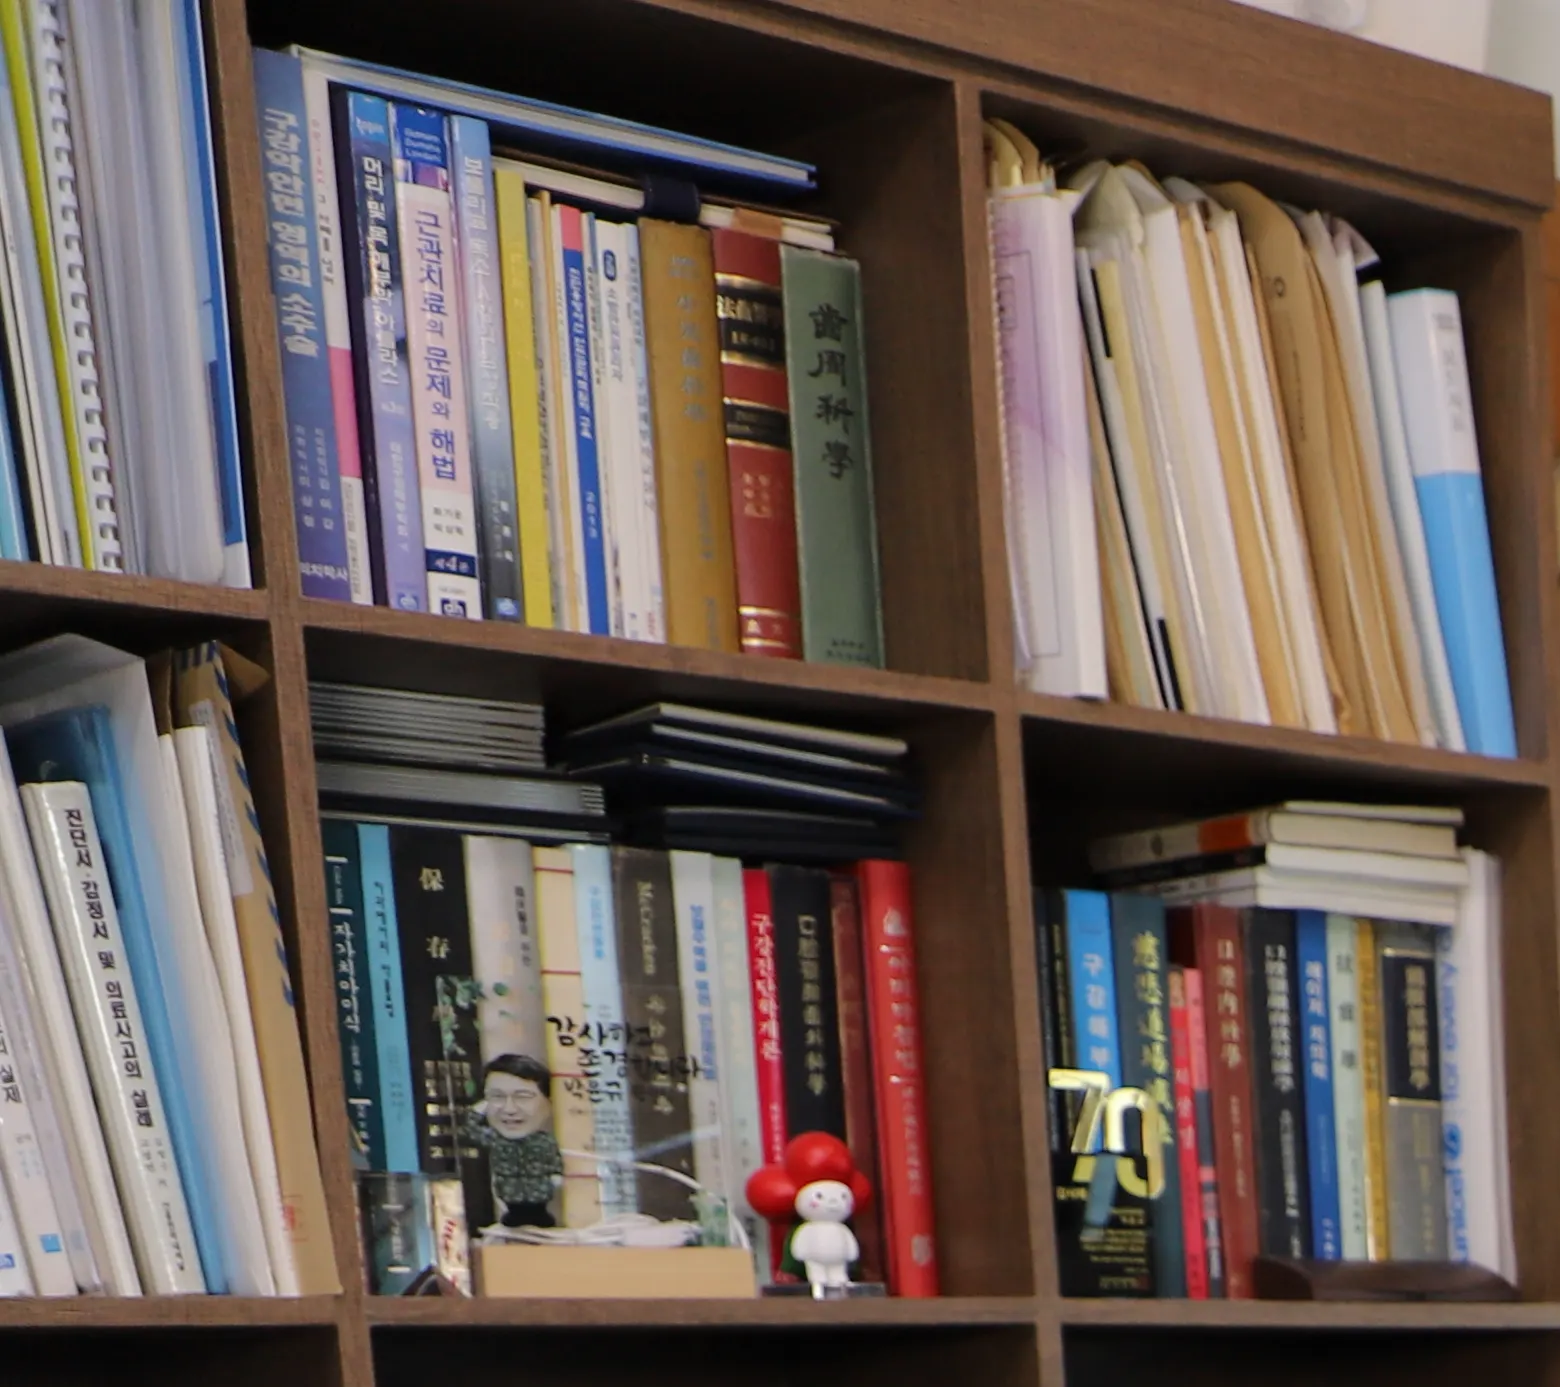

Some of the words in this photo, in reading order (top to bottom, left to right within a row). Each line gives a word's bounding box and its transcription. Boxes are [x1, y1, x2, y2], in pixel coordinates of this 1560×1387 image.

[415, 210, 448, 337] 근관치료의
[425, 345, 452, 421] 문제와
[429, 428, 457, 482] 해법
[97, 949, 117, 971] 및
